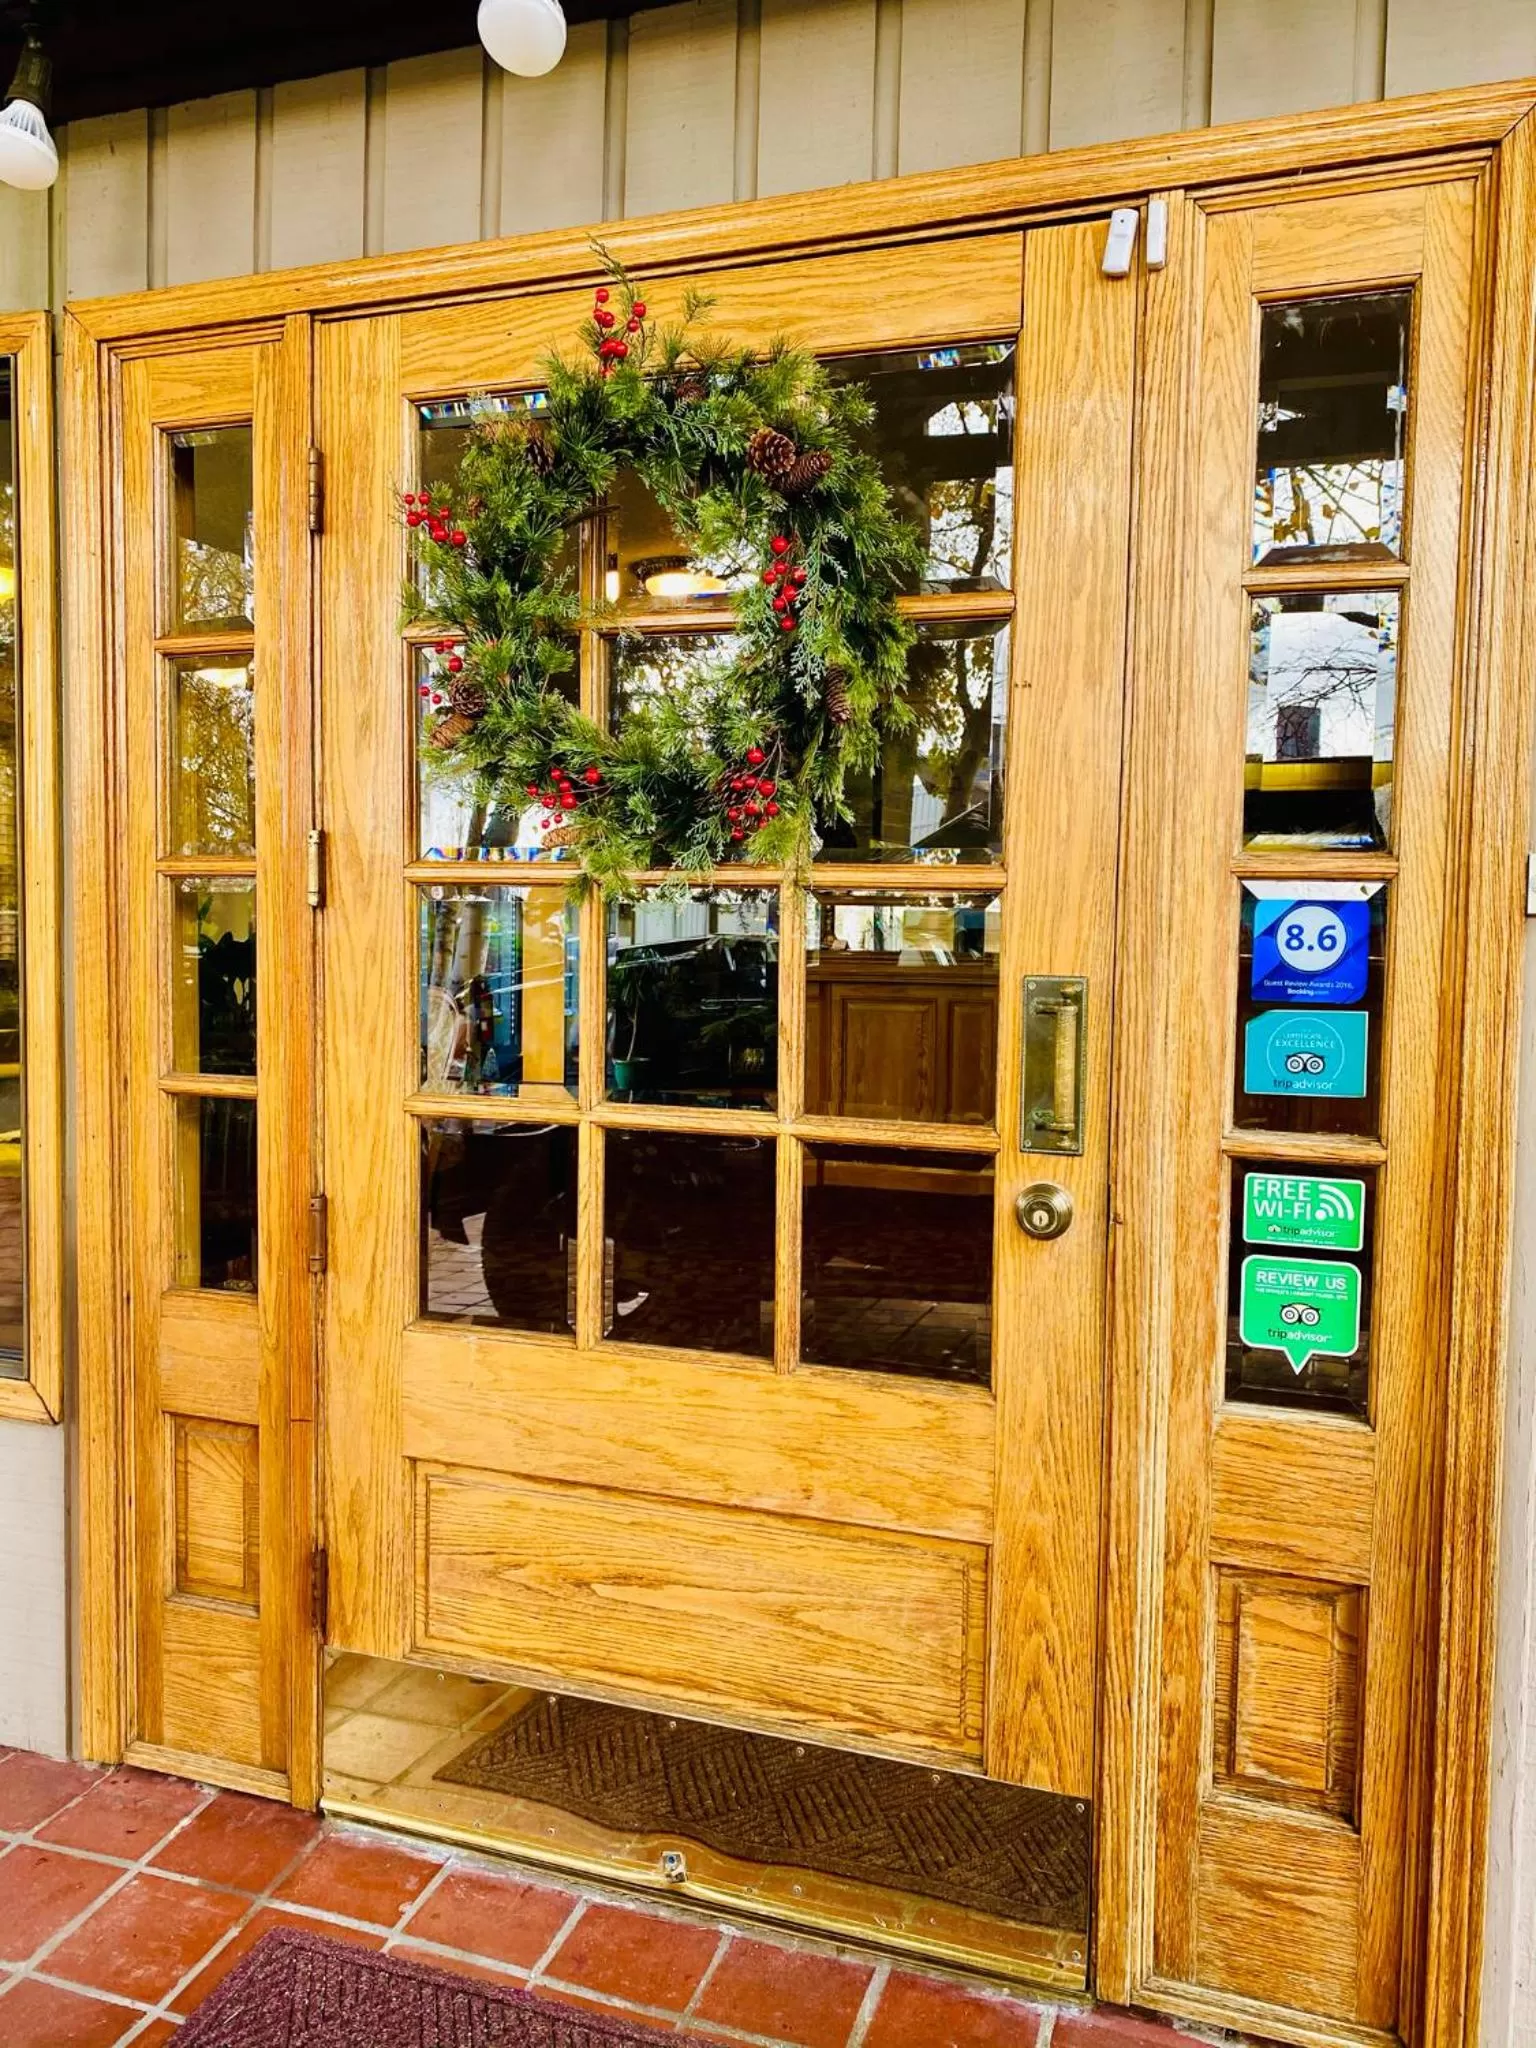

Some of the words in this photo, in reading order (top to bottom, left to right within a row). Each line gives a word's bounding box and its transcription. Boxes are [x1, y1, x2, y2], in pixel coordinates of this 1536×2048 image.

[1285, 924, 1337, 951] 8.6
[1263, 979, 1284, 987] Guest
[1275, 1039, 1336, 1049] EXCELLENCE
[1273, 1079, 1334, 1090] tripadvisor
[1252, 1179, 1312, 1201] FREE
[1253, 1199, 1312, 1221] WI-FI
[1282, 1225, 1336, 1237] tripadvisor
[1256, 1270, 1319, 1288] REVIEW
[1325, 1277, 1347, 1290] US
[1267, 1328, 1329, 1342] tripadvisor
